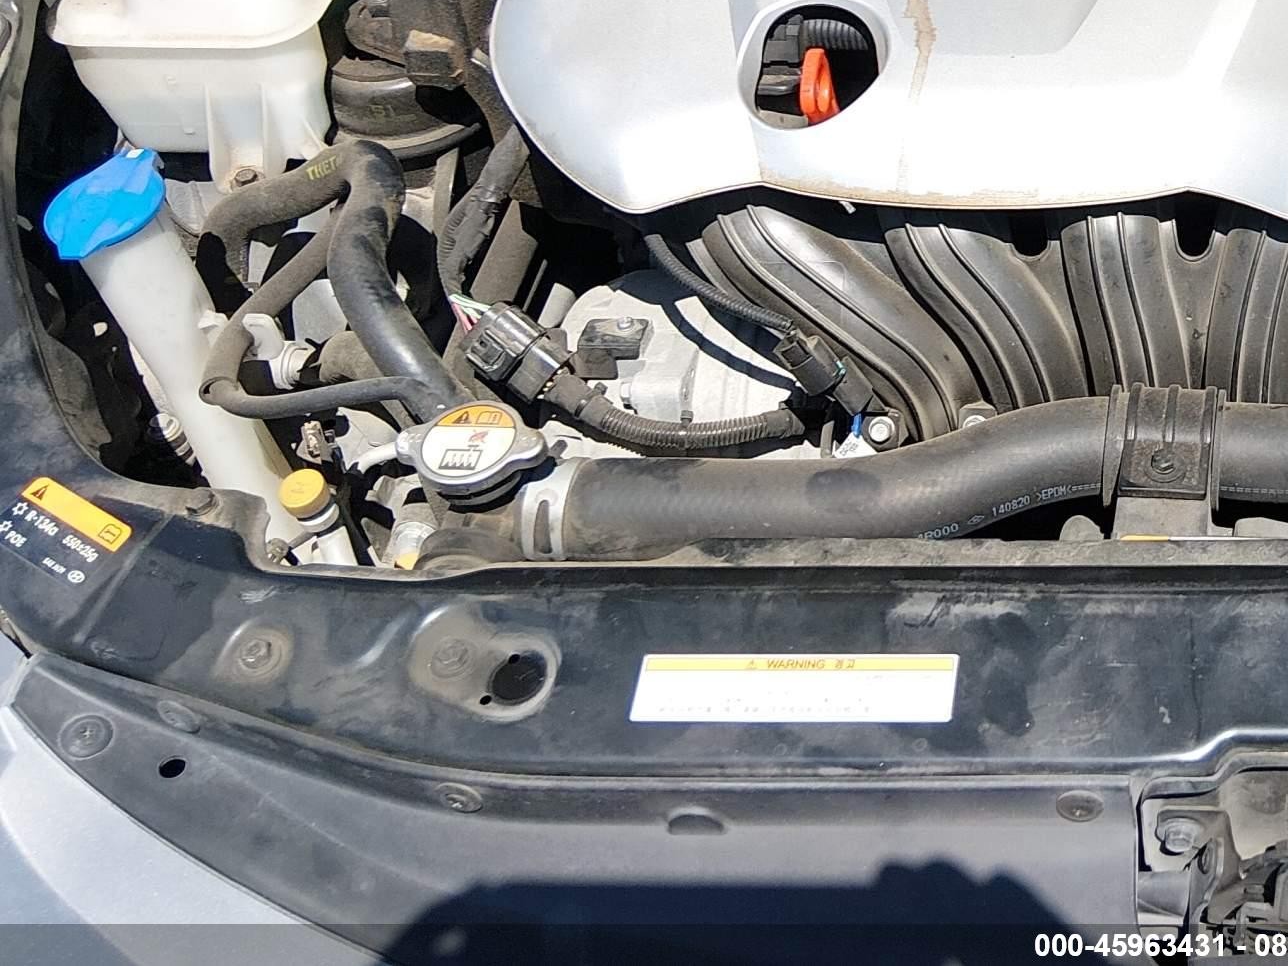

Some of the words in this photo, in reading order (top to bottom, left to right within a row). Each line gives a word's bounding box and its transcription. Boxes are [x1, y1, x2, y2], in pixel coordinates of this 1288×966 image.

[992, 495, 1030, 517] 140820
[4, 530, 28, 548] POE
[767, 658, 826, 669] WARNING
